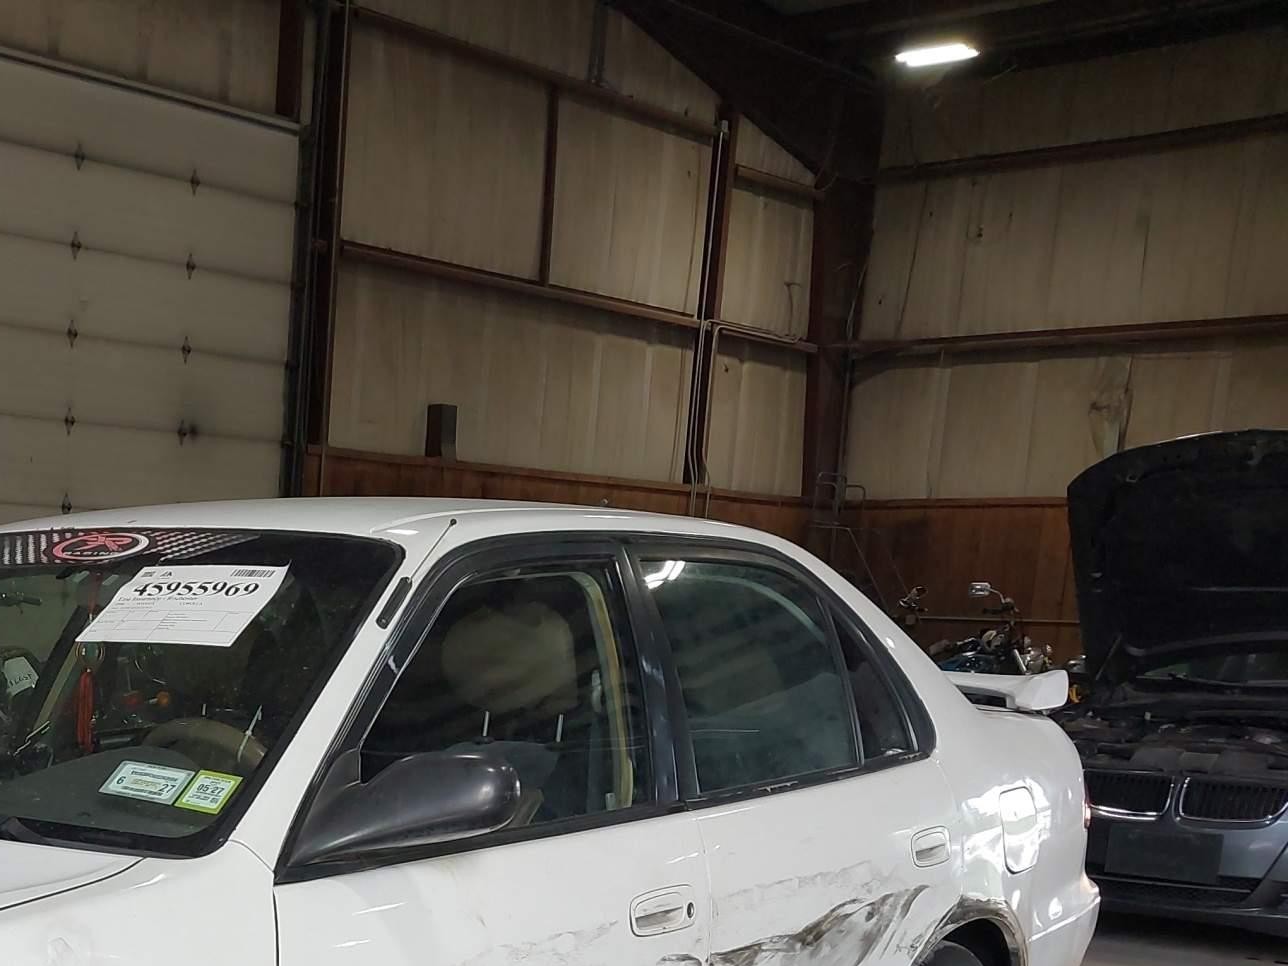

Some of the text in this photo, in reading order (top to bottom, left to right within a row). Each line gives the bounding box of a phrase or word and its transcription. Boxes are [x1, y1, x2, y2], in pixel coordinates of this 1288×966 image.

[133, 581, 260, 597] 45955969
[116, 776, 126, 784] 6
[159, 784, 176, 793] 27
